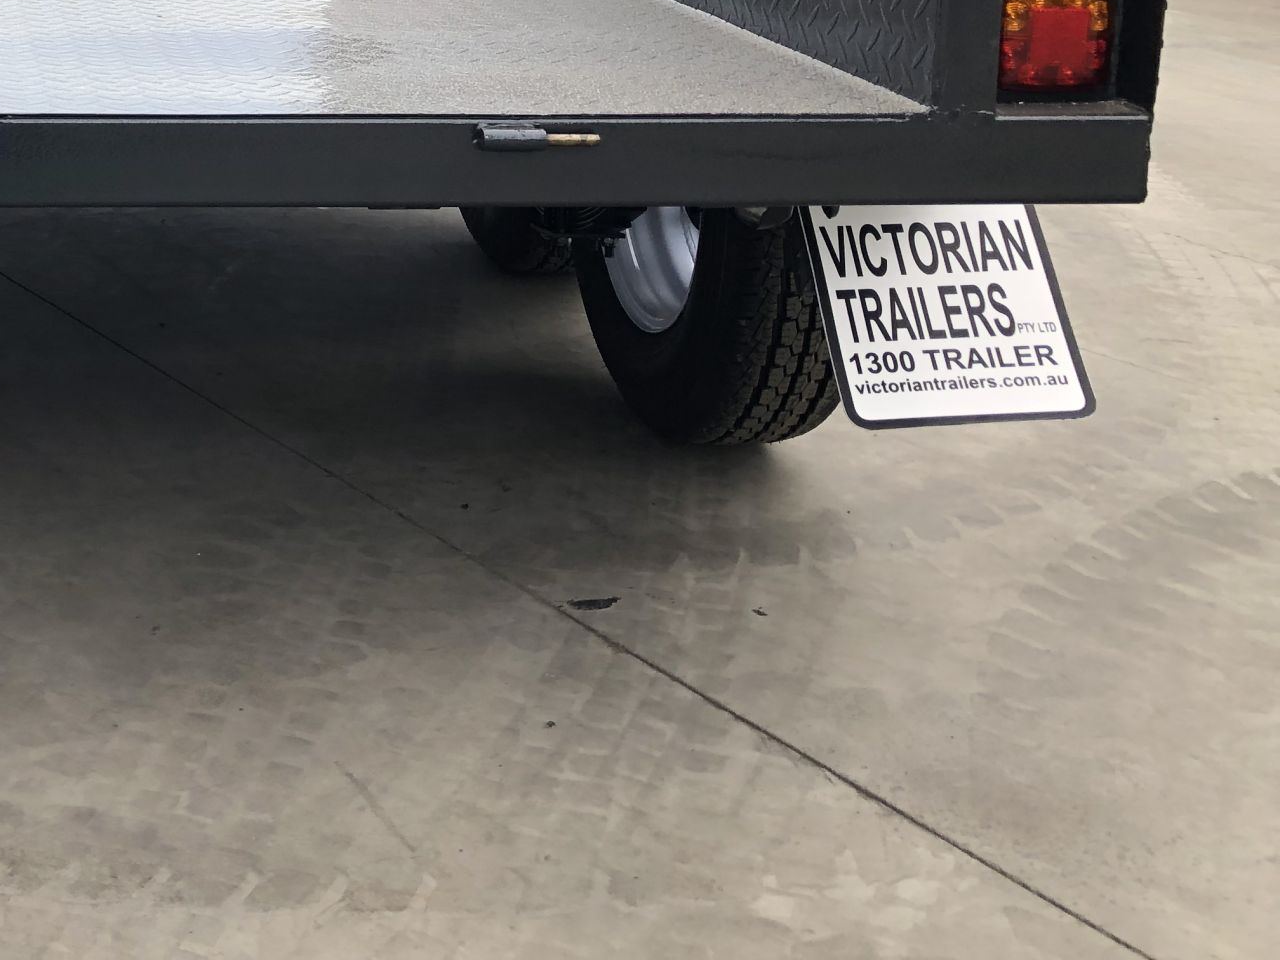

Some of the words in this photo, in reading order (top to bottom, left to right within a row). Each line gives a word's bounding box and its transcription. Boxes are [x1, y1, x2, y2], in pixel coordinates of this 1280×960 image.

[819, 219, 1034, 278] VICTORIAN
[836, 283, 1016, 343] TRAILERS
[1017, 322, 1035, 334] PTY
[1038, 321, 1057, 333] LTD
[849, 351, 916, 374] 1300
[922, 345, 1058, 371] TRAILER
[854, 374, 1069, 395] victoriantrailers.com.au
